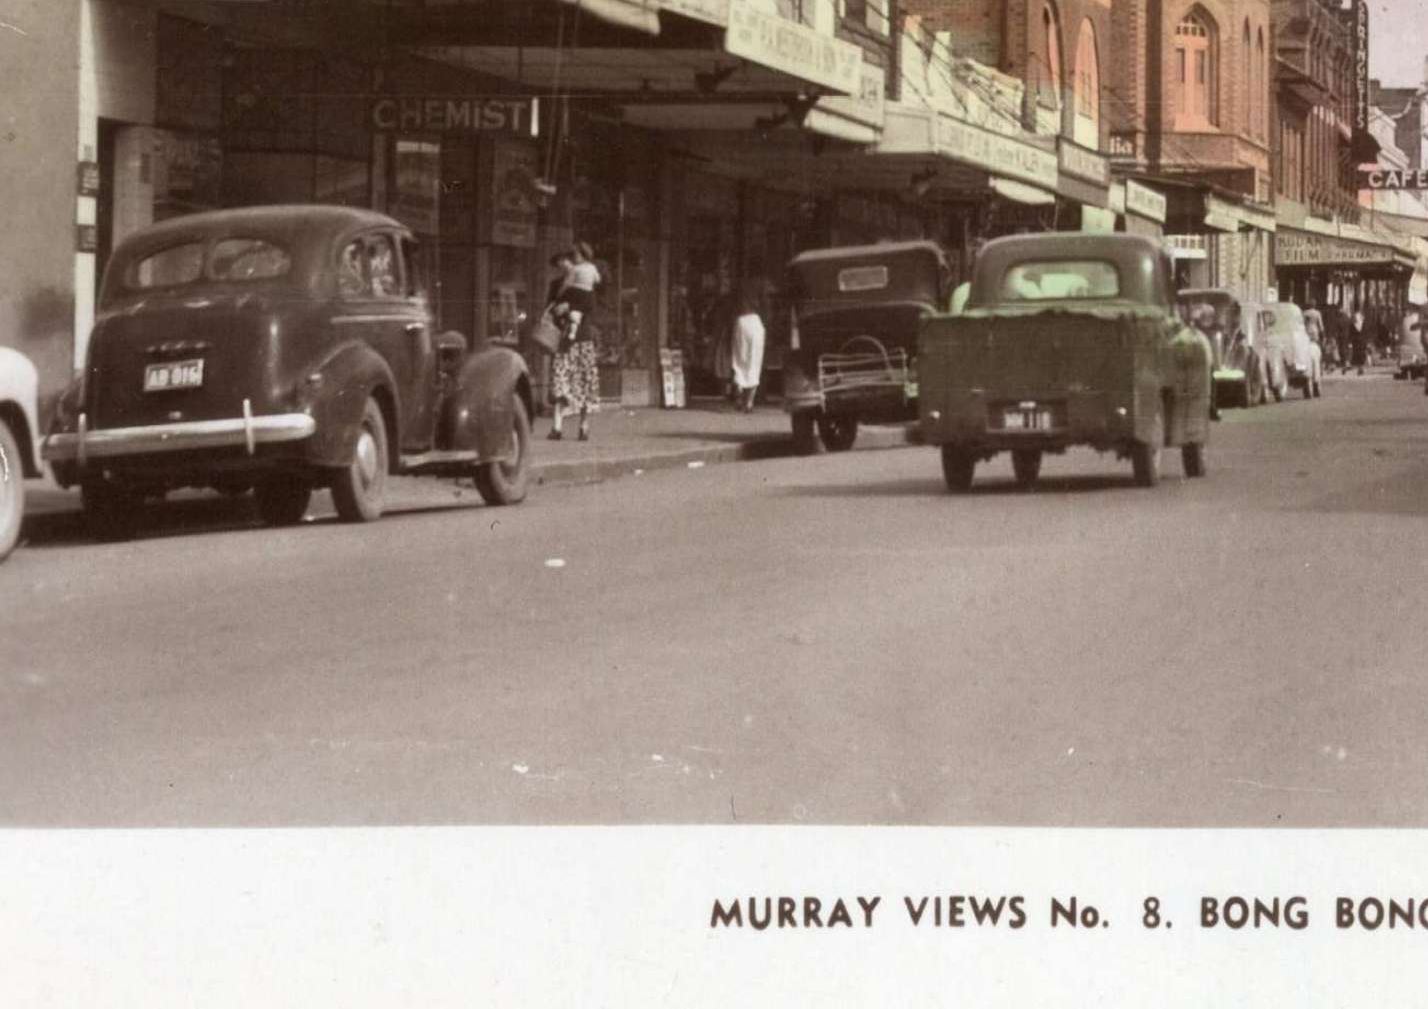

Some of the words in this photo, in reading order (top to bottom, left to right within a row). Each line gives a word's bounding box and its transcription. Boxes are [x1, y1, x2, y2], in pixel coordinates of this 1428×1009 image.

[372, 99, 528, 131] CHEMIST
[1367, 171, 1428, 188] CAFE
[1284, 249, 1319, 261] FILM
